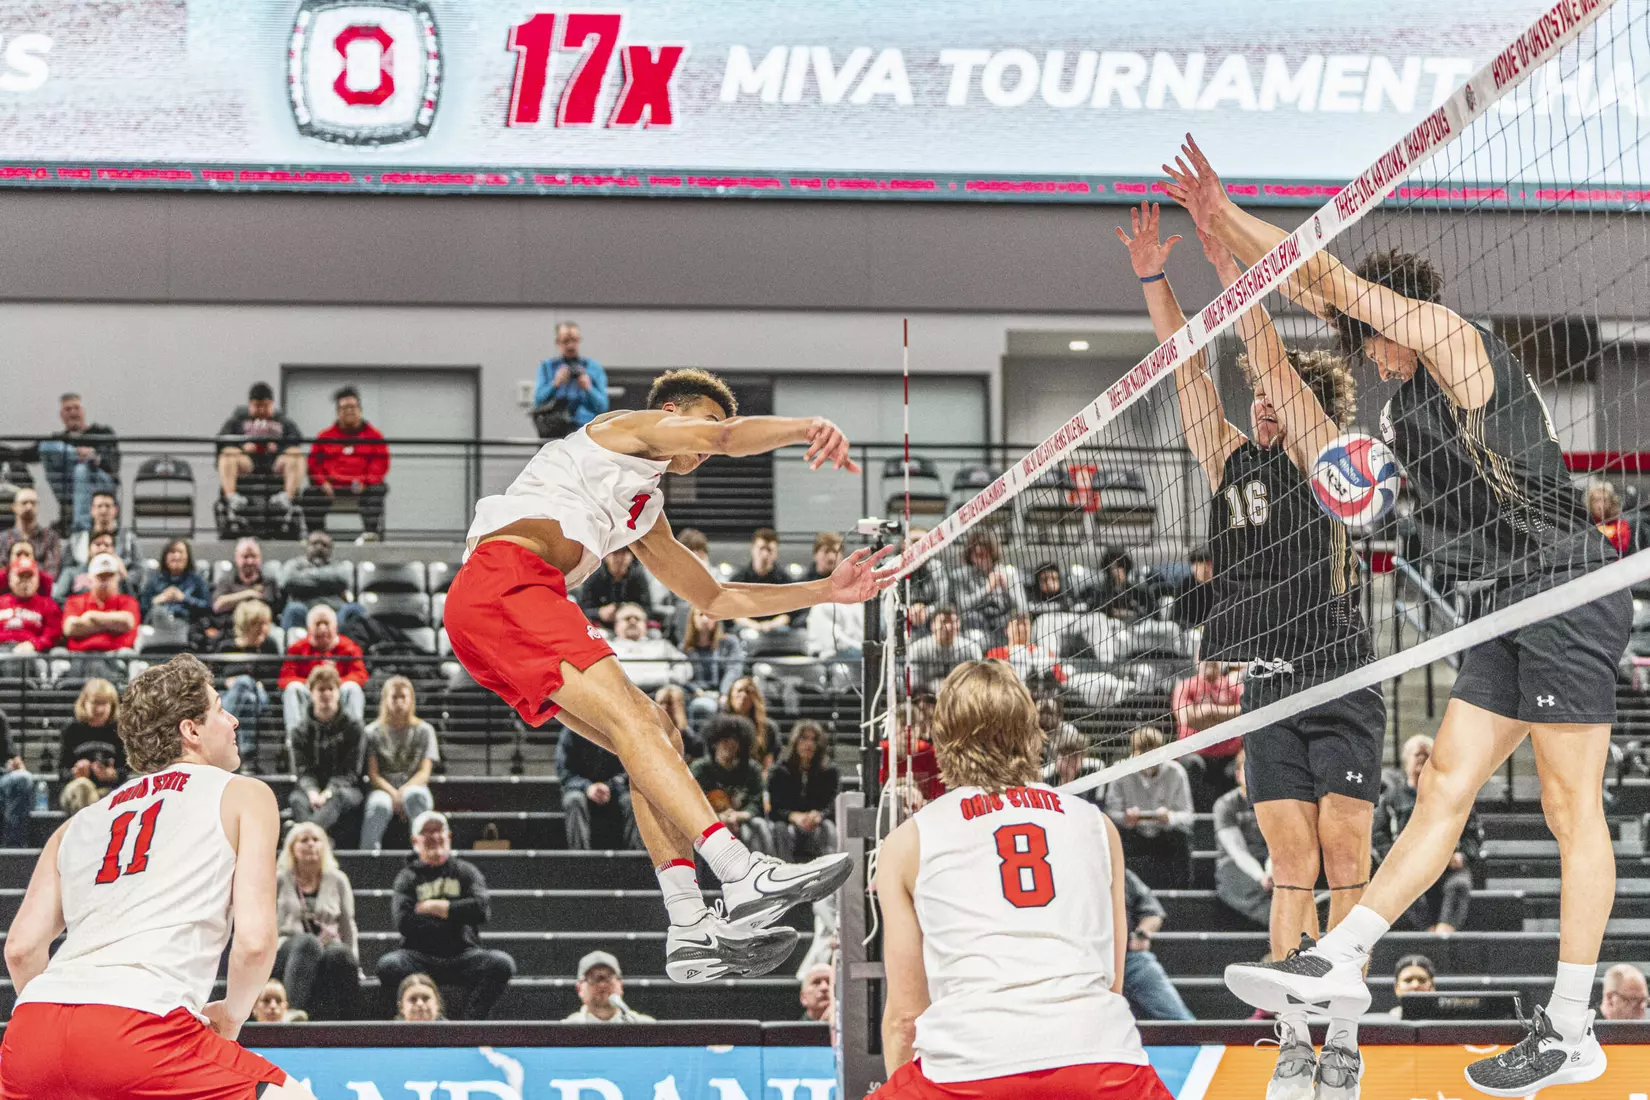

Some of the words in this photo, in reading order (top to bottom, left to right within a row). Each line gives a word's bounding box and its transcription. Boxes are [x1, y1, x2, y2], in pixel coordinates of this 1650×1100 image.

[507, 13, 688, 128] 17x
[719, 45, 914, 105] MIVA
[940, 49, 1474, 113] TOURNAMENT
[626, 494, 652, 530] 1
[1224, 479, 1268, 529] 16
[151, 771, 191, 796] STATE
[960, 791, 1005, 821] OHIO
[1005, 785, 1066, 815] STATE
[94, 798, 165, 885] 11
[993, 822, 1056, 908] 8
